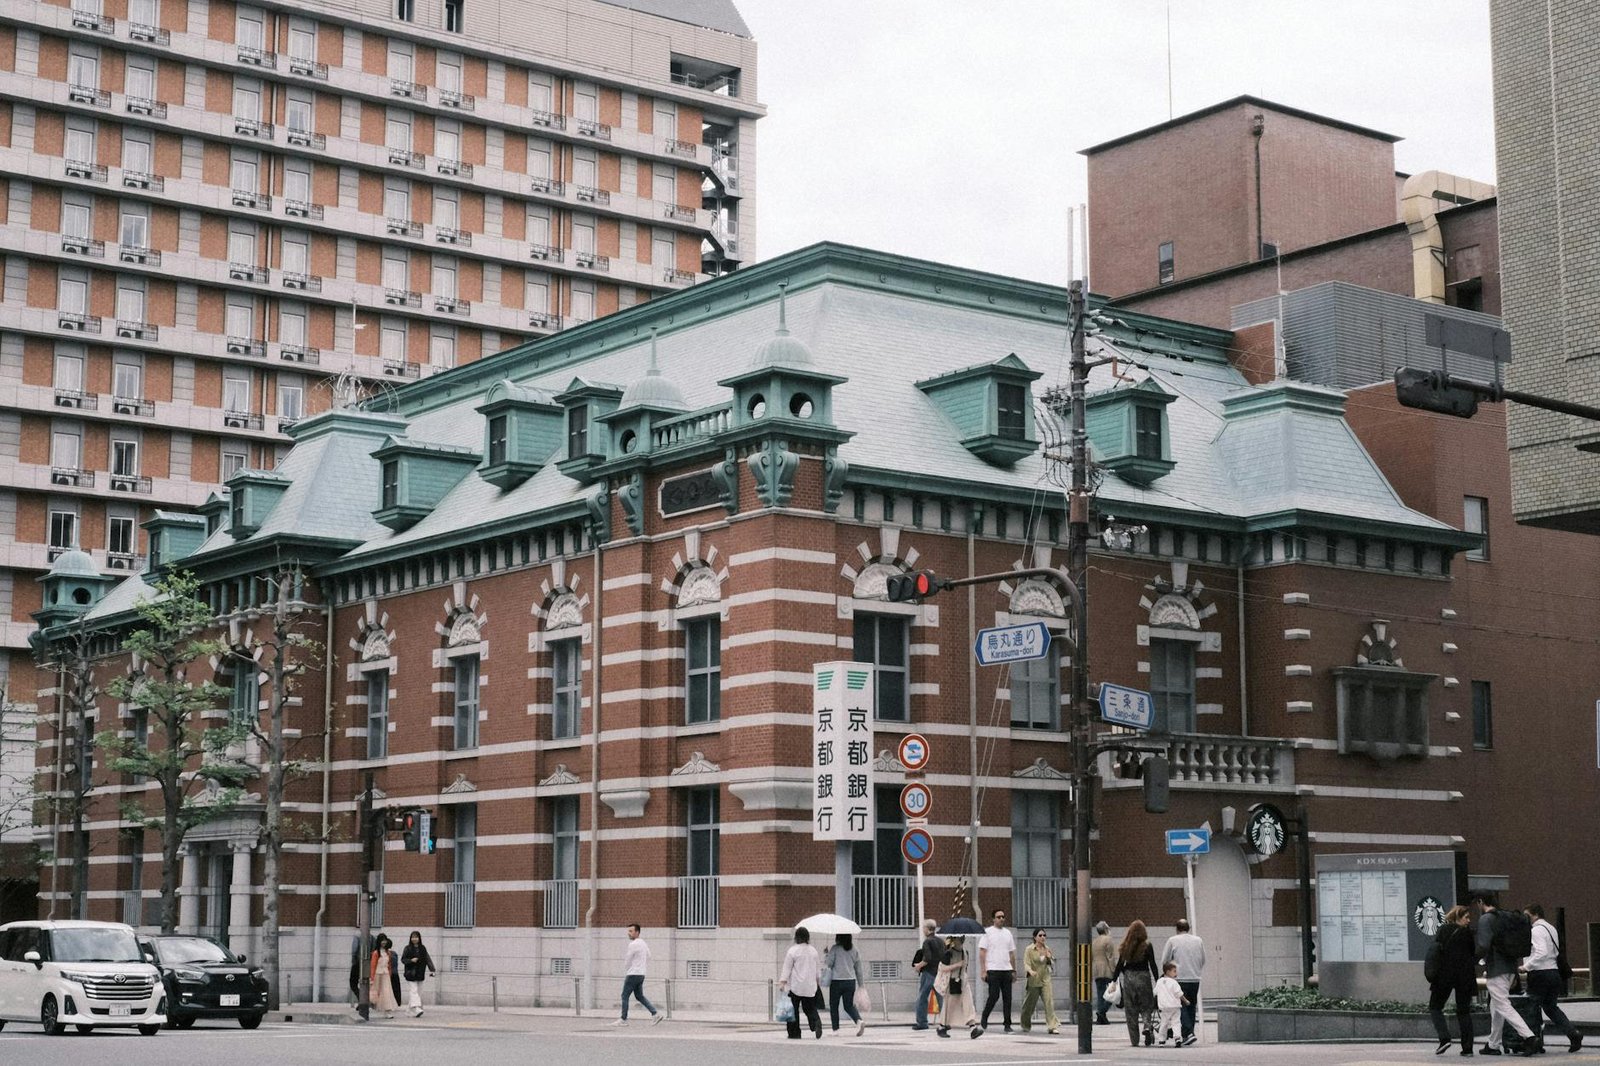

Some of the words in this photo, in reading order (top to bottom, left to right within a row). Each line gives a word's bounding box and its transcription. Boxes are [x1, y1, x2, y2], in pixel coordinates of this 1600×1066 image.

[988, 628, 1036, 650] 烏丸通り
[991, 646, 1035, 659] Karasuma-dori
[817, 706, 834, 832] 京都銀行
[847, 706, 868, 832] 京都銀行
[907, 792, 925, 808] 30
